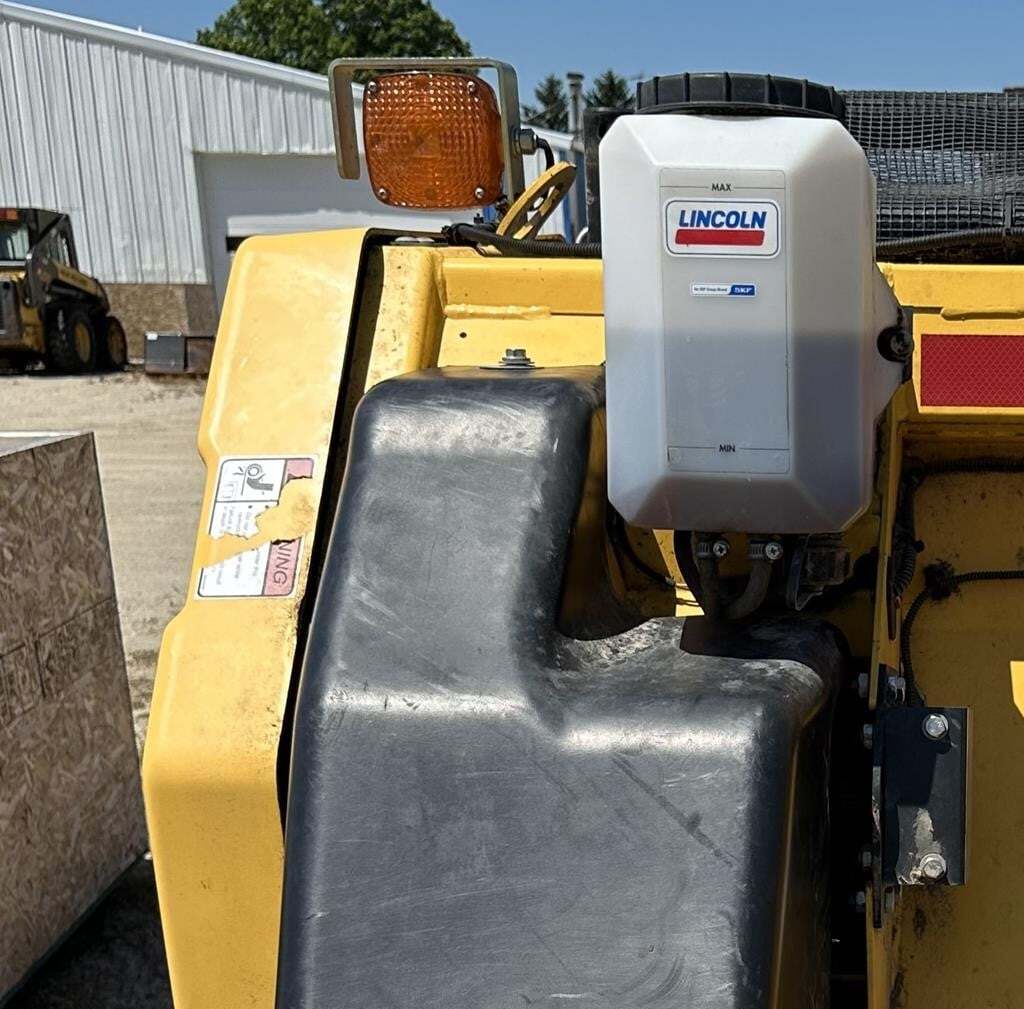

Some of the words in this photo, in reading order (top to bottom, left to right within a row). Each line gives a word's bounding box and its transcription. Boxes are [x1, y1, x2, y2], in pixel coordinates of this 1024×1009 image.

[711, 183, 732, 192] MAX
[678, 209, 767, 229] LINCOLN
[719, 444, 735, 452] MIN
[273, 542, 292, 585] NING
